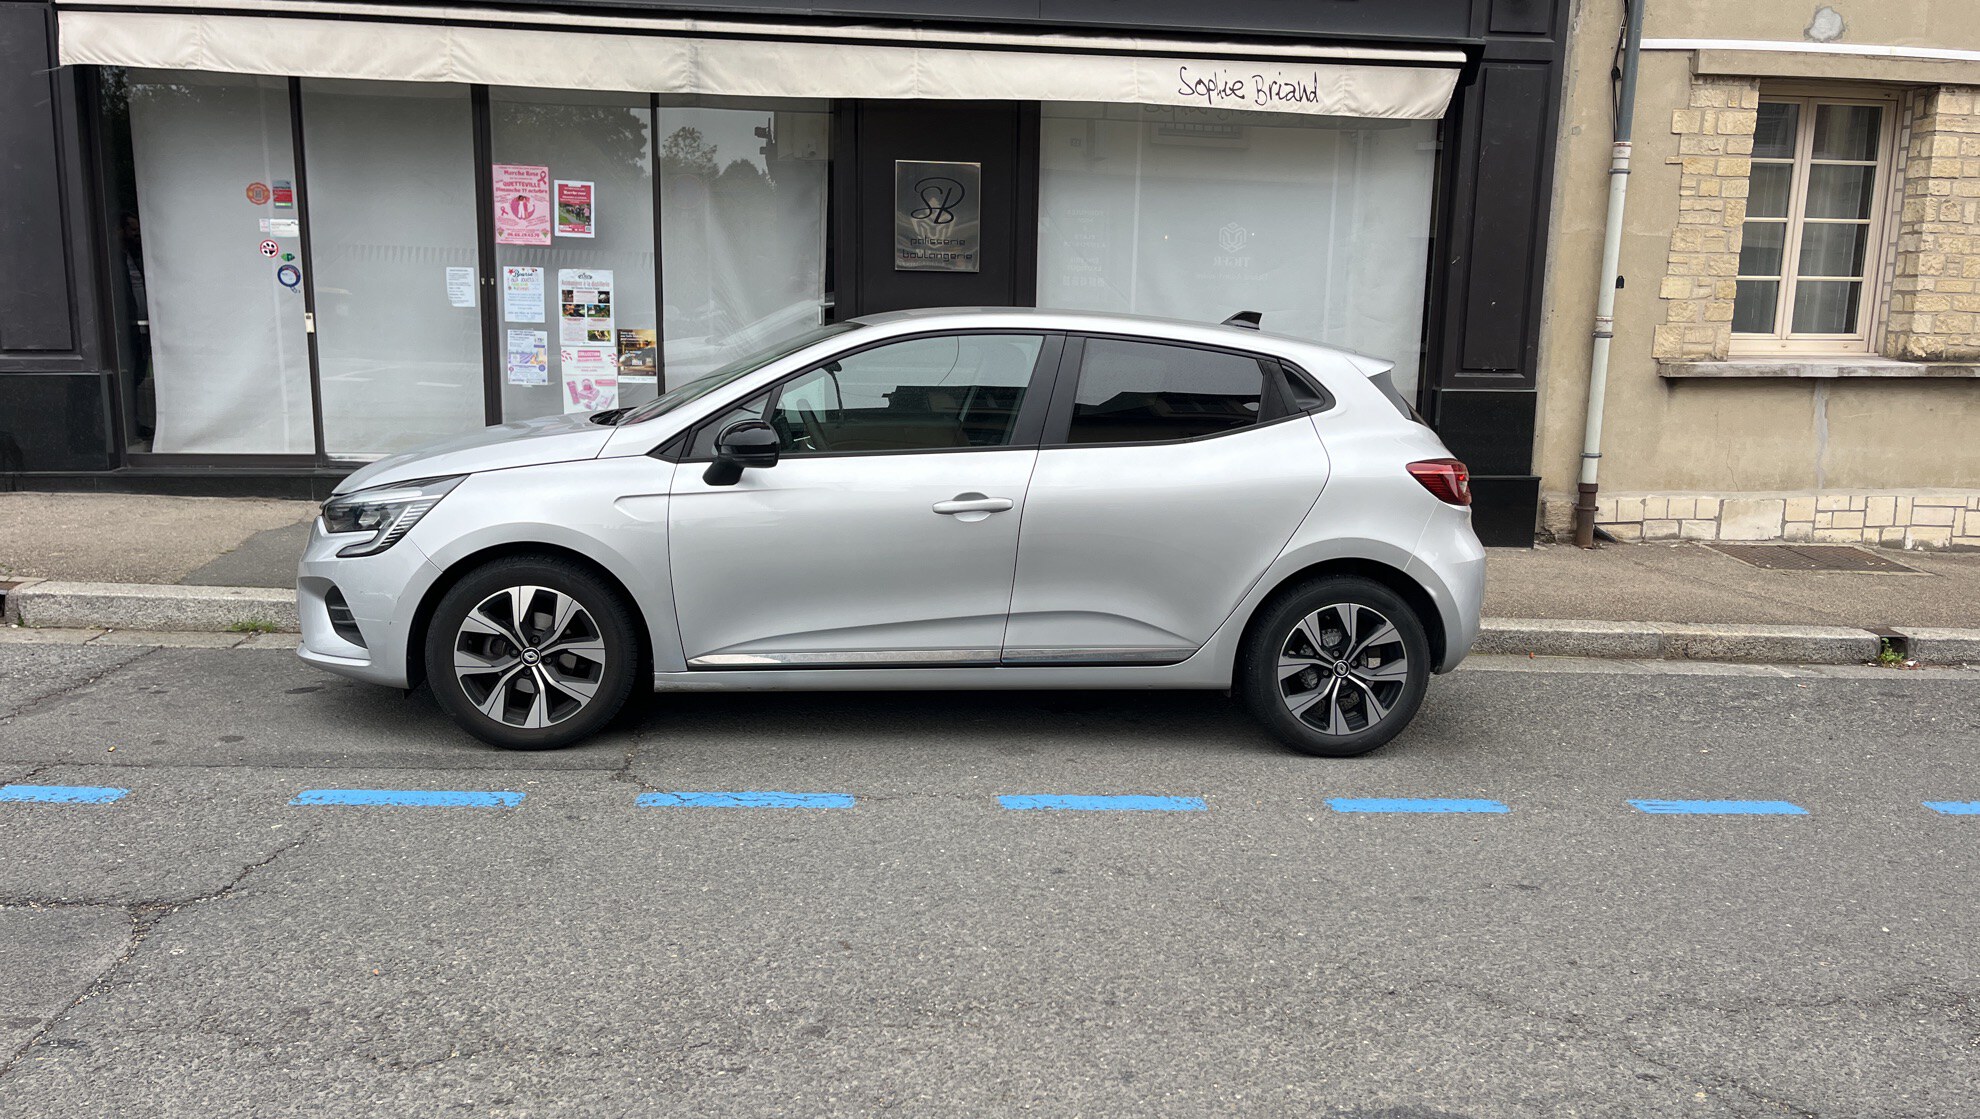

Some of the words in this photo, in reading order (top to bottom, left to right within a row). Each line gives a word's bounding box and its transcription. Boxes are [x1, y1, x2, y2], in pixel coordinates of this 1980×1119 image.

[1178, 66, 1245, 105] Sophie
[1251, 71, 1319, 106] Briand
[911, 177, 965, 224] SB
[902, 249, 973, 262] boulangerie
